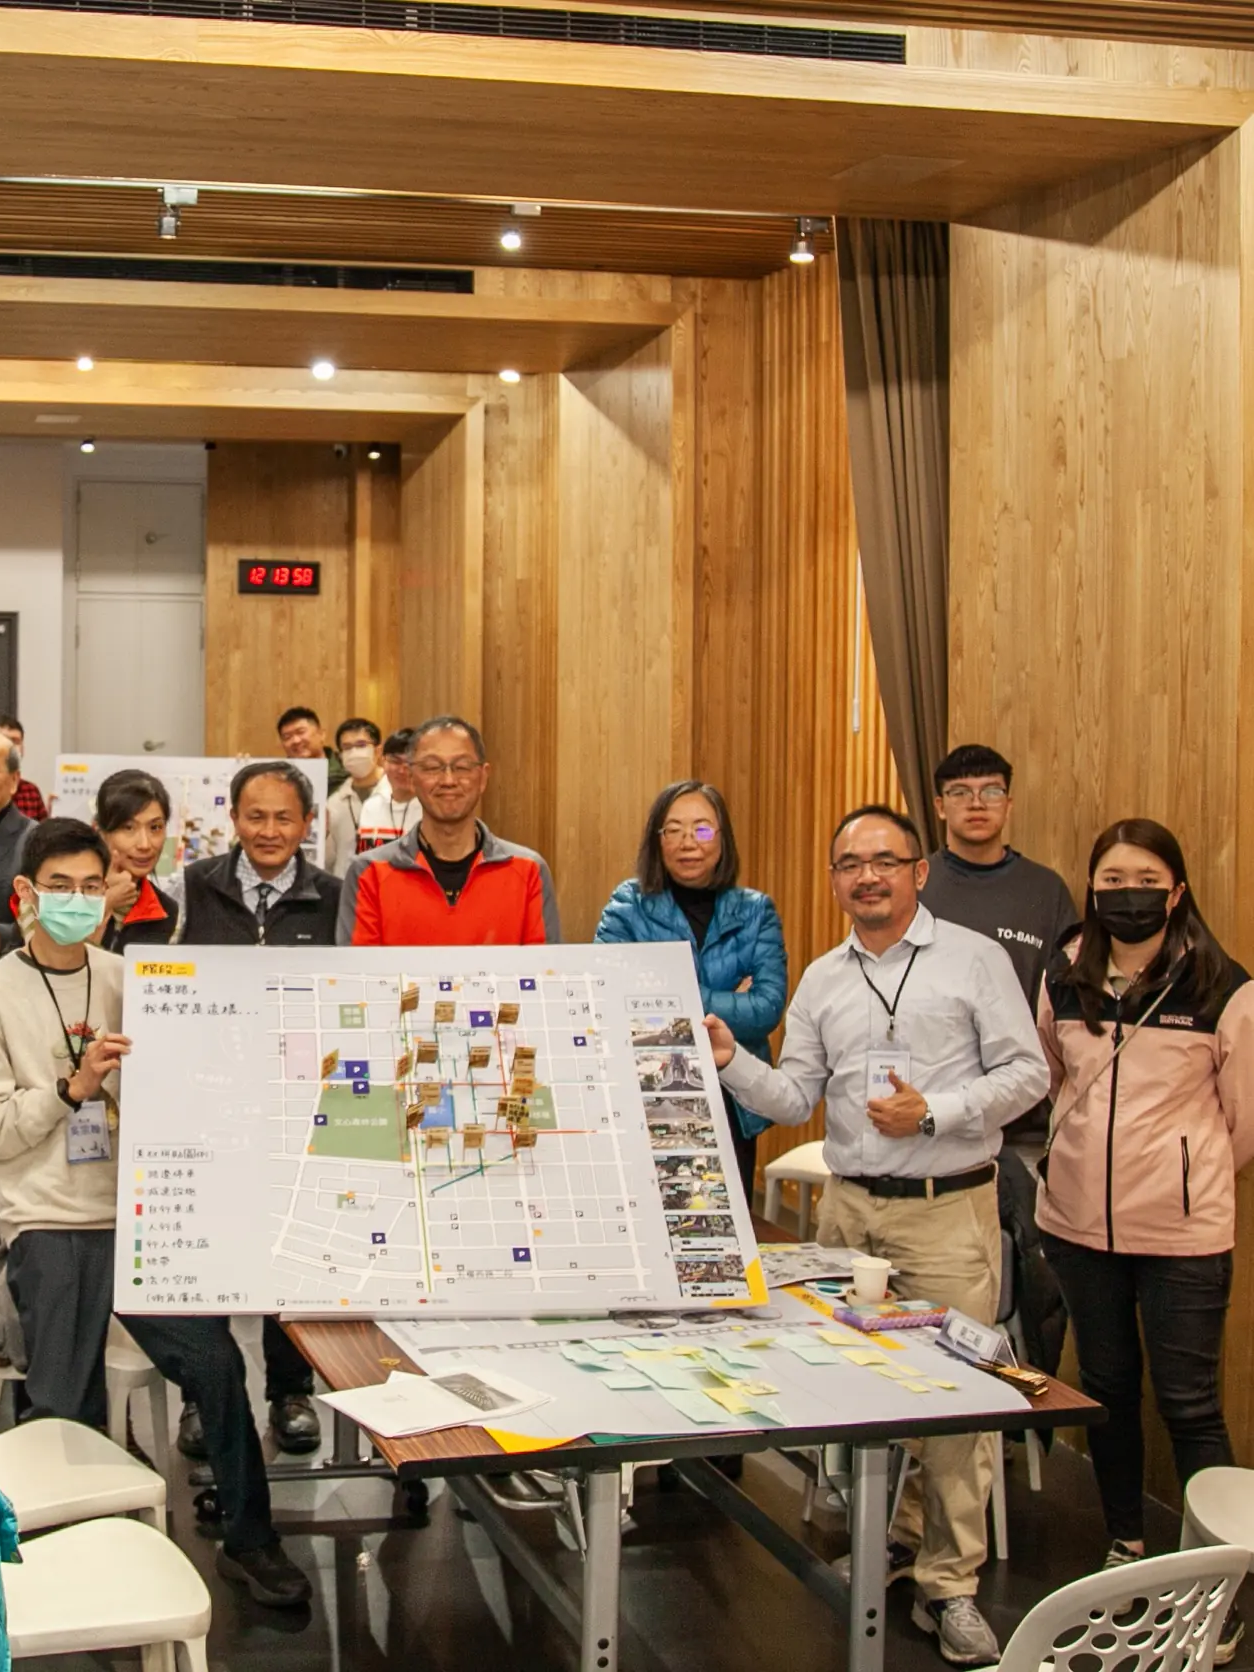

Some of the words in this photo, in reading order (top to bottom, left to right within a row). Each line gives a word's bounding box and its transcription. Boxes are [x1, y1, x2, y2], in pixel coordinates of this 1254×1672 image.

[249, 567, 266, 585] 12
[273, 567, 290, 585] 13
[292, 567, 313, 586] 58
